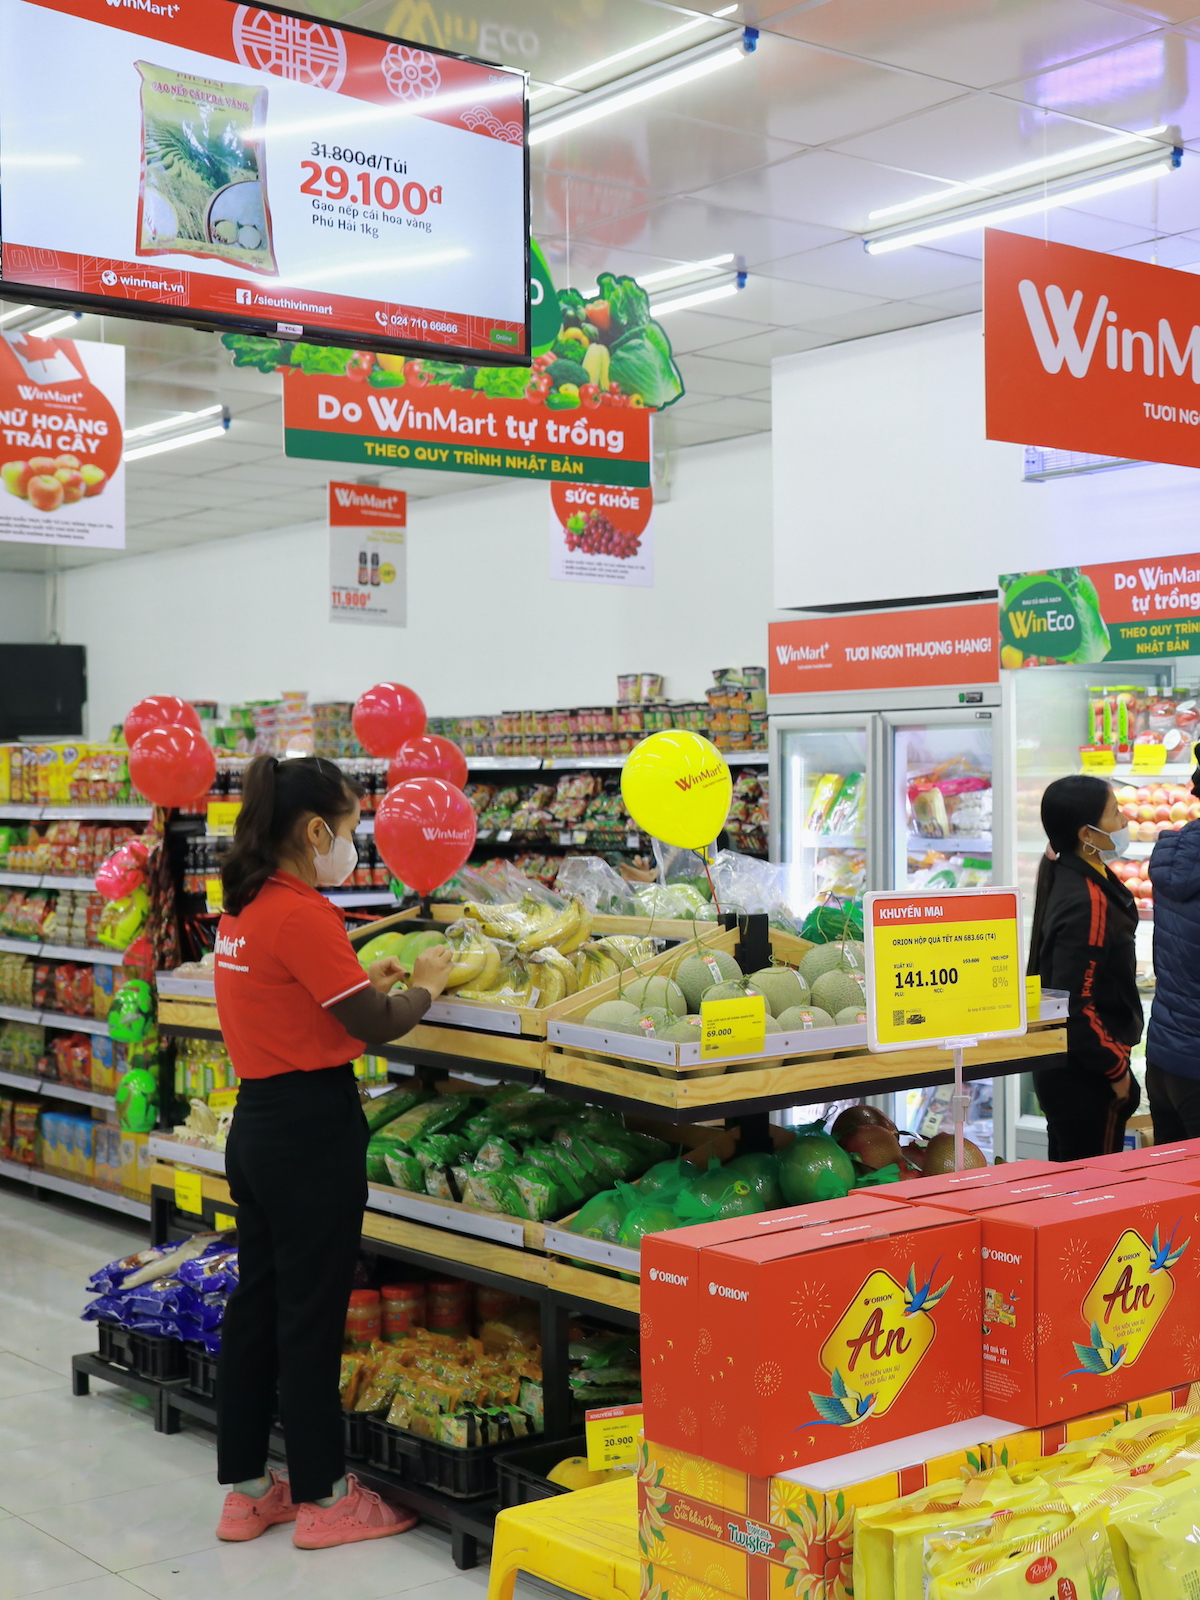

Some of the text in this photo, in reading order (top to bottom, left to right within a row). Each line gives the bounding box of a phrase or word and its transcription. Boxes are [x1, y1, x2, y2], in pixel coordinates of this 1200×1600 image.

[301, 160, 442, 215] 29.100đ
[312, 199, 432, 233] Gạo nếp cái hoa vàng
[313, 214, 379, 239] Phú Hải 1kg
[120, 275, 185, 294] winmart.vn
[254, 293, 333, 315] /sieuthivinmart
[390, 315, 458, 334] 024 710 66866
[1143, 402, 1177, 422] TƯƠI
[32, 412, 108, 436] HOÀNG
[318, 394, 625, 453] Do WinMart tự trồng
[3, 427, 101, 454] TRÁI CÂY
[364, 442, 584, 475] THEO QUY TRÌNH NHẬT BẢN
[565, 488, 640, 510] SỨC KHỎE
[1114, 572, 1137, 590] Do
[1132, 587, 1200, 615] tự trồng
[1008, 609, 1075, 639] WinEco
[1120, 627, 1148, 639] THEO
[1150, 624, 1172, 637] QUY
[776, 642, 830, 665] WinMart+
[845, 637, 992, 662] TƯƠI NGON THƯỢNG HẠNG!
[1136, 638, 1189, 655] NHẬT BẢN
[674, 762, 722, 792] WinMart+
[879, 904, 943, 919] KHUYẾN MẠI
[895, 968, 958, 989] 141.100
[992, 976, 1009, 988] 8%
[707, 1028, 731, 1037] 69.000
[991, 1249, 1022, 1265] ORION
[659, 1270, 689, 1287] ORION
[718, 1283, 749, 1302] ORION
[1103, 1264, 1155, 1325] An
[846, 1307, 912, 1372] An
[605, 1436, 633, 1447] 20.900
[746, 1521, 770, 1539] Tropicana
